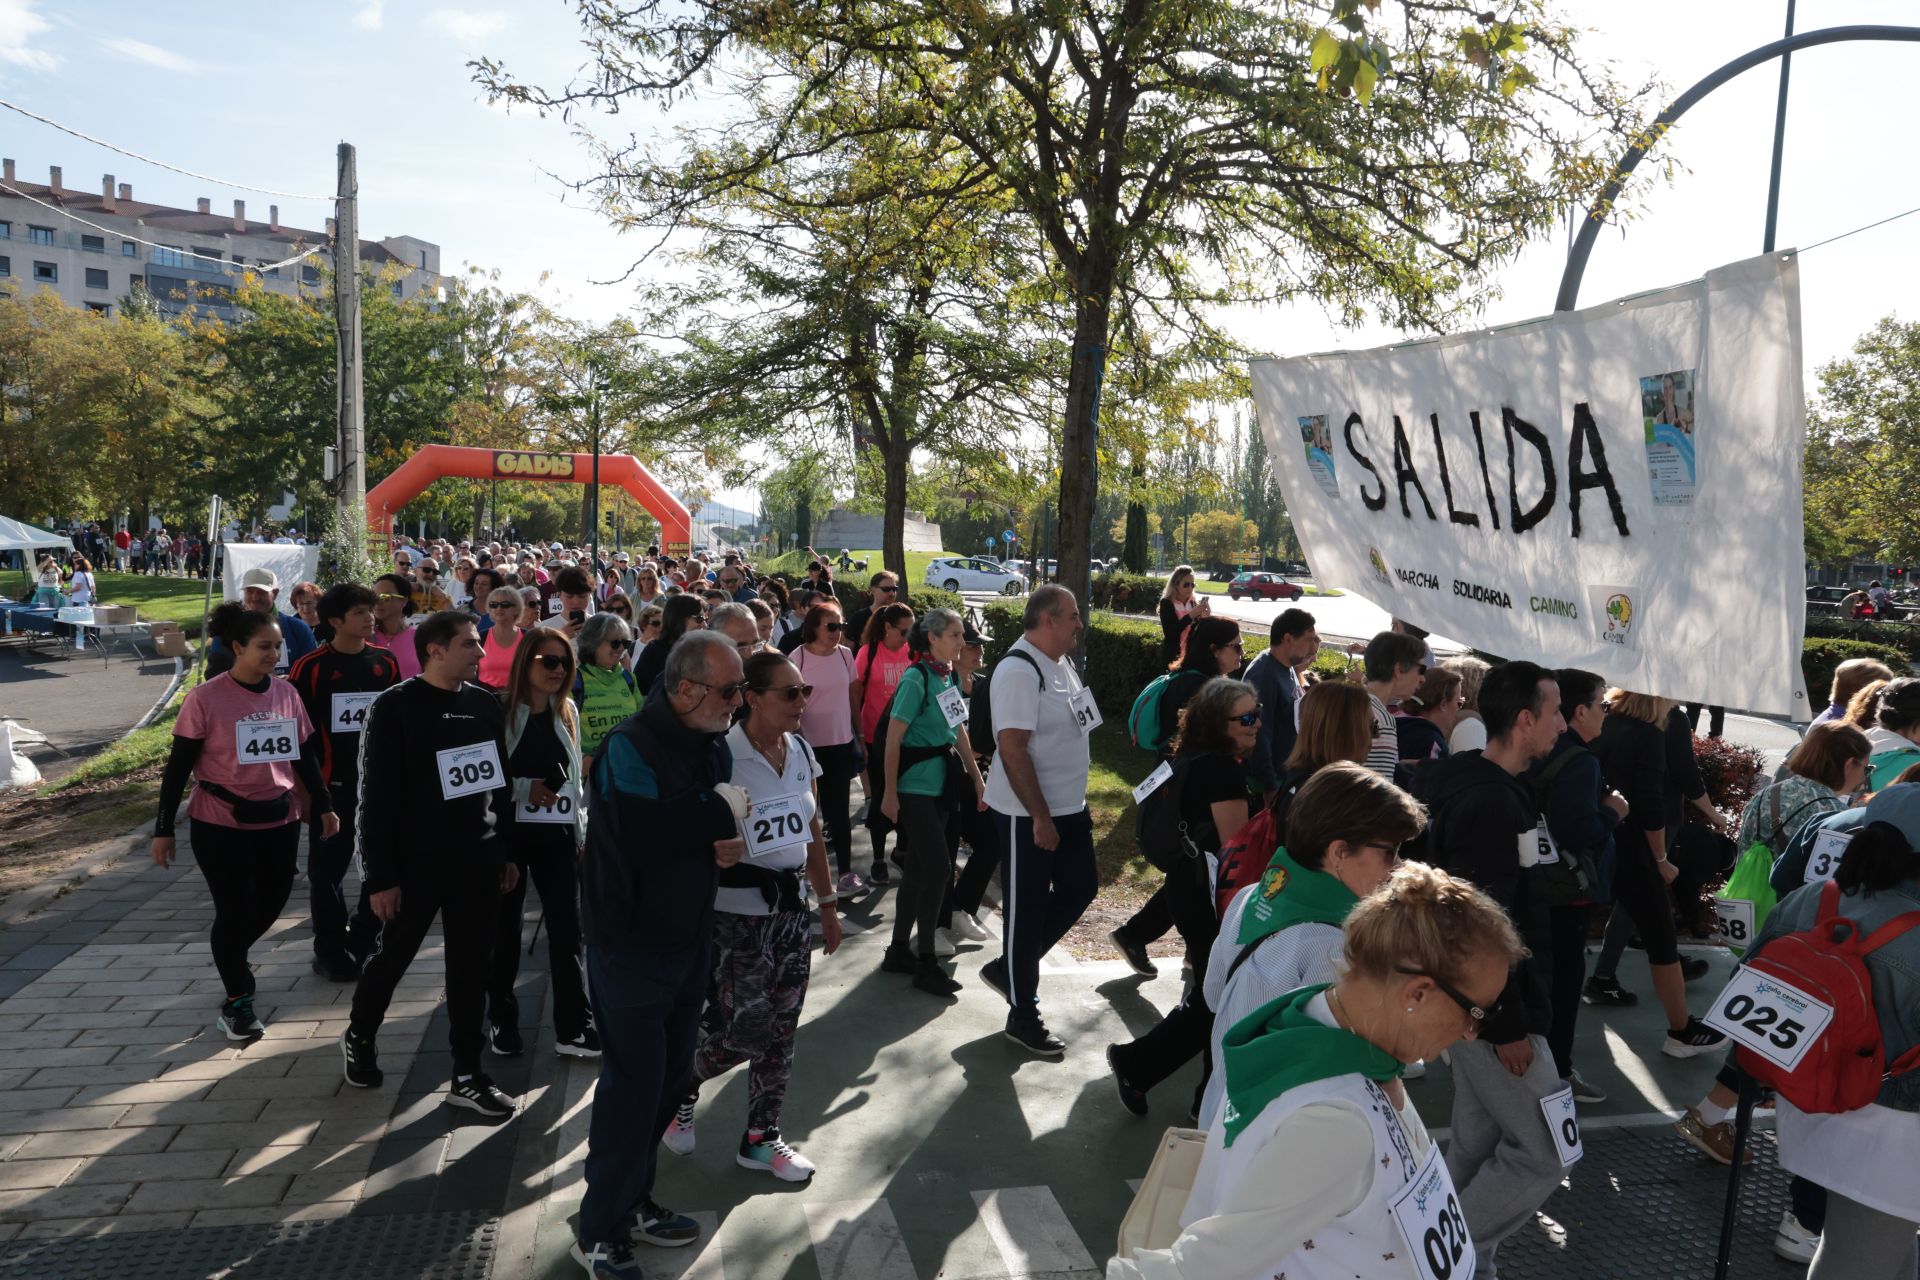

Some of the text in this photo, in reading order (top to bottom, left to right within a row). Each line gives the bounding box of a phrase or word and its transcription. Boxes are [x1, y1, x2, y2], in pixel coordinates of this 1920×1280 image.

[497, 453, 573, 476] GADIS
[1344, 403, 1630, 537] SALIDA
[1453, 579, 1513, 609] SOLIDARIA
[1530, 597, 1578, 620] CAMINO
[588, 713, 633, 728] En ma
[246, 737, 292, 756] 448
[449, 760, 495, 787] 309
[753, 812, 803, 843] 270
[1722, 994, 1806, 1050] 025
[1424, 1192, 1467, 1280] 028
